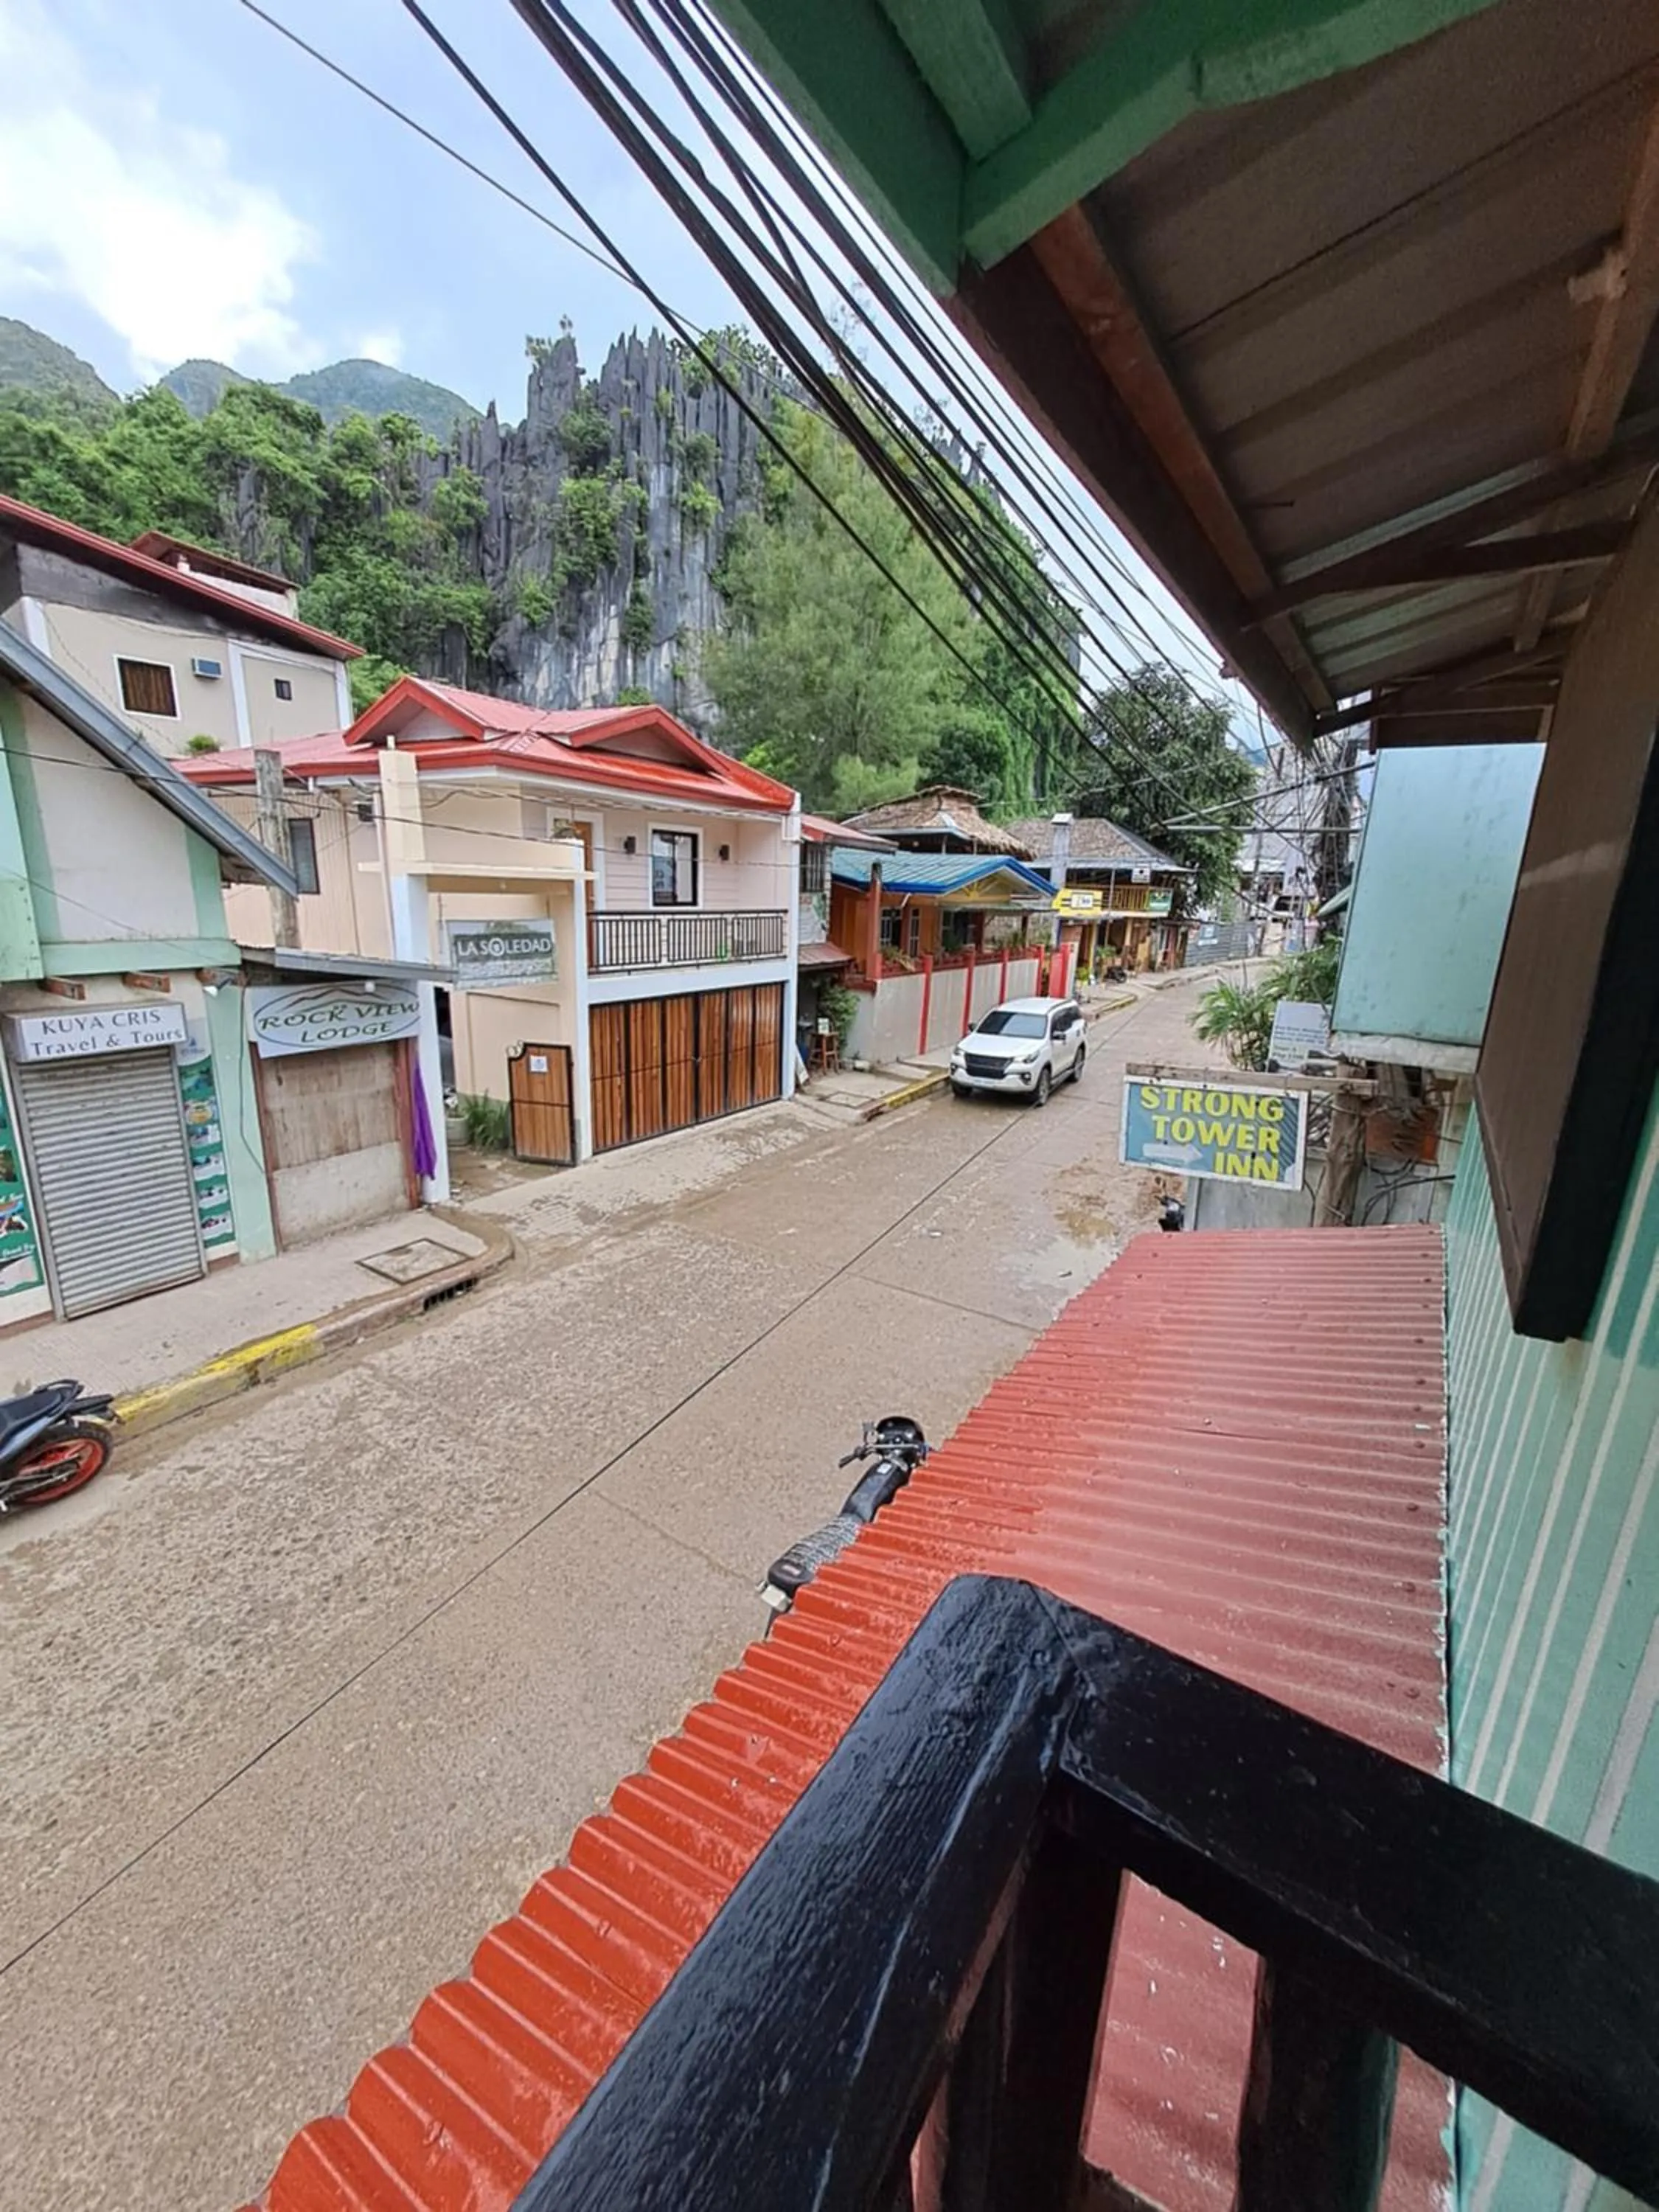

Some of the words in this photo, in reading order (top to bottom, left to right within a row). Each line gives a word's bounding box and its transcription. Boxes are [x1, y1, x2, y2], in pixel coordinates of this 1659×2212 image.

[457, 941, 478, 956] LA
[480, 937, 552, 956] SOLEDAD
[42, 1016, 104, 1035] KUYA
[113, 1009, 161, 1027] CRIS
[259, 1007, 347, 1030] ROCK
[355, 1002, 420, 1019] VIEW
[30, 1037, 97, 1057] Travel
[106, 1034, 121, 1048] &
[131, 1029, 183, 1045] Tours
[301, 1020, 392, 1043] LODGE
[1140, 1086, 1284, 1121] STRONG
[1152, 1115, 1281, 1153] TOWER
[1214, 1152, 1279, 1181] INN
